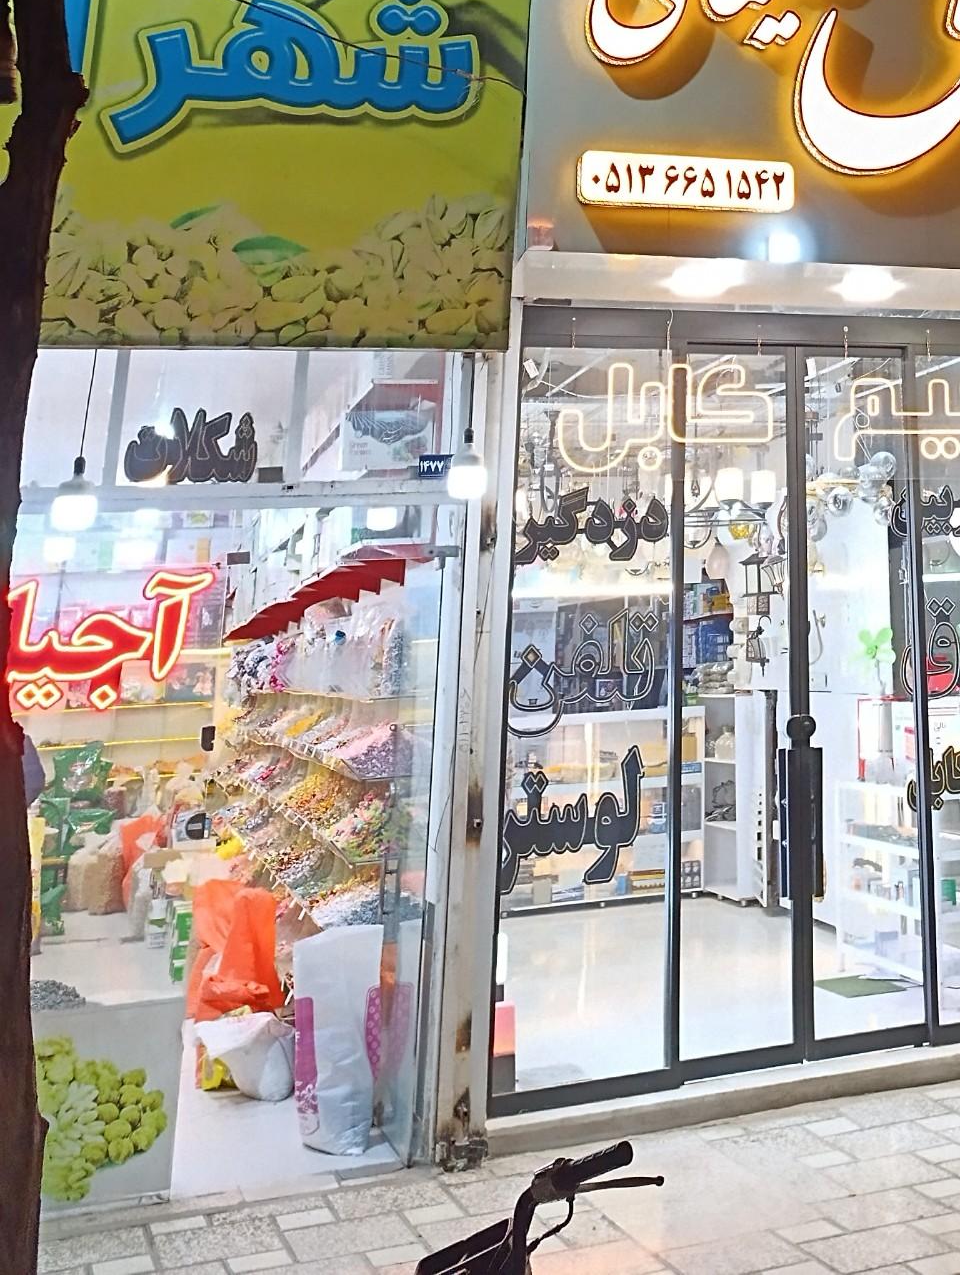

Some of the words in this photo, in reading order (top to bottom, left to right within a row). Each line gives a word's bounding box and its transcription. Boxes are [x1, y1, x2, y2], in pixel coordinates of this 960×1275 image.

[592, 162, 655, 194] ۰۵۱۳
[663, 165, 717, 199] ۶۶۵
[726, 169, 785, 201] ۱۵۴۲
[124, 407, 258, 484] شکلات
[556, 362, 775, 474] کابل
[514, 486, 669, 565] دزدگیر
[507, 607, 659, 738] تلفن
[502, 745, 645, 895] لوستر
